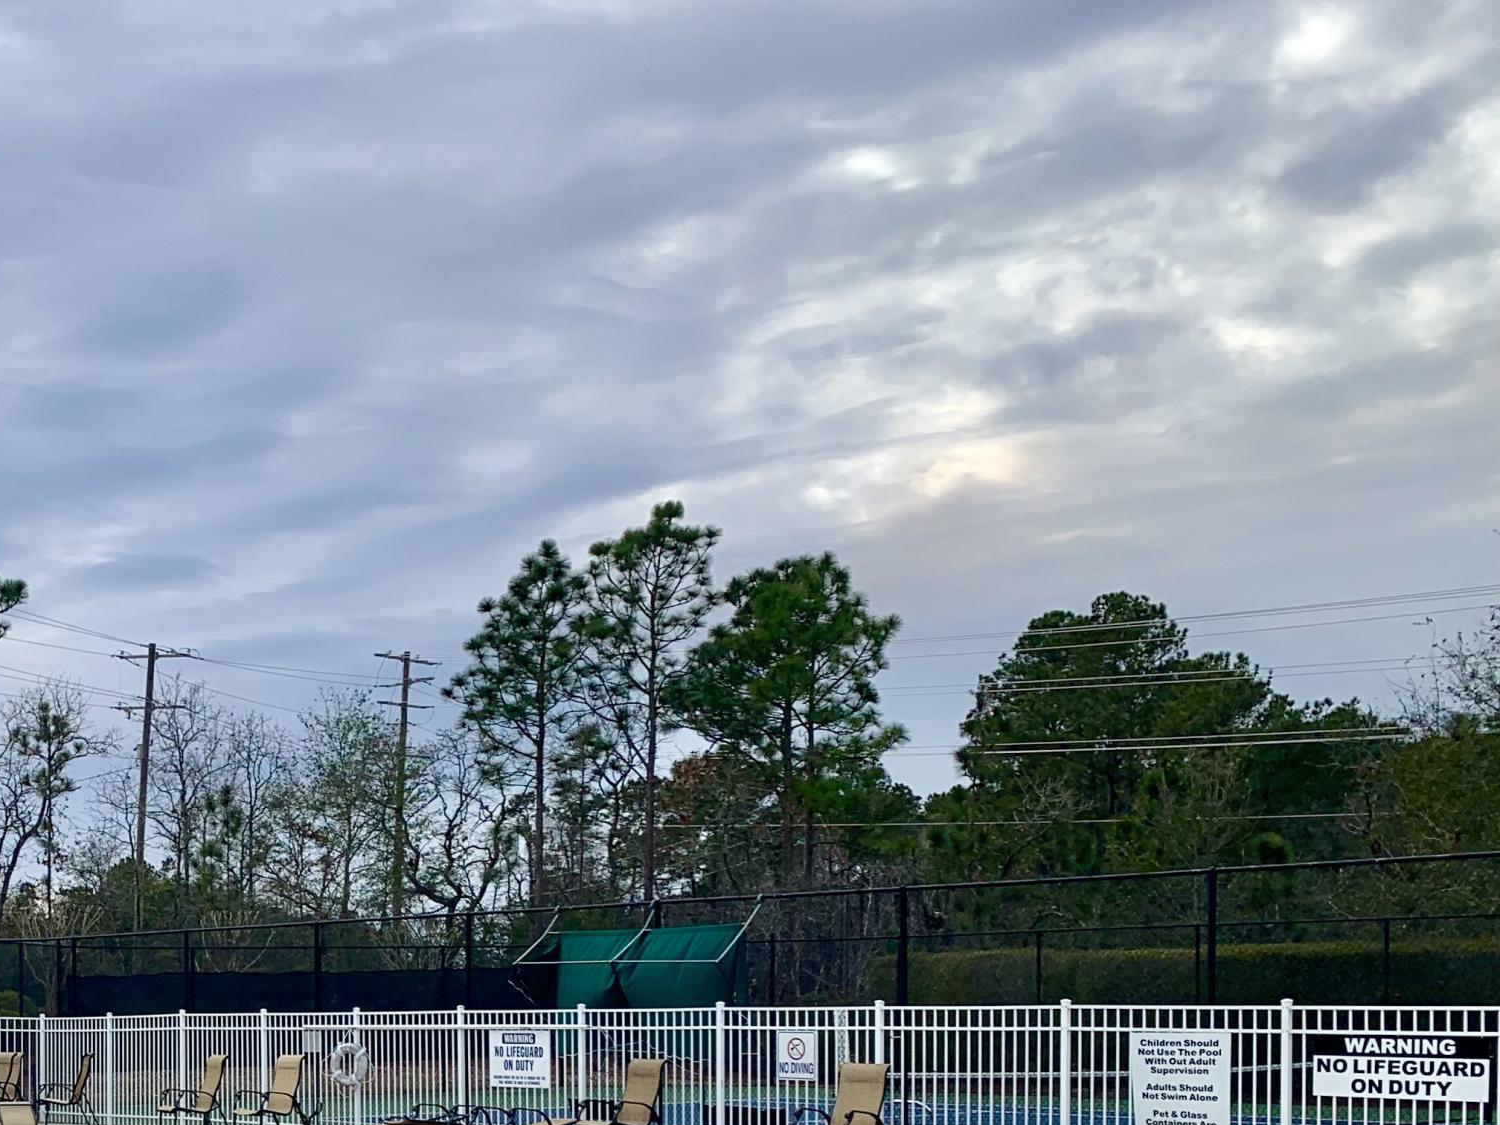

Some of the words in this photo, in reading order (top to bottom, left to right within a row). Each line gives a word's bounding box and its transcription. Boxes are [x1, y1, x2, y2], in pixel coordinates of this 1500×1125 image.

[504, 1035, 533, 1043] WARNING
[1184, 1039, 1219, 1047] Should
[1345, 1038, 1456, 1055] WARNING
[495, 1047, 504, 1057] NO
[507, 1047, 543, 1057] LIFEGUARD
[504, 1060, 513, 1070] ON
[516, 1060, 533, 1071] DUTY
[779, 1063, 789, 1073] NO
[791, 1063, 813, 1074] DIVING
[1317, 1059, 1347, 1072] NO
[1353, 1059, 1485, 1077] LIFEGUARD
[1151, 1067, 1209, 1075] Supervision
[1352, 1079, 1382, 1093] ON
[1389, 1081, 1452, 1096] DUTY
[1181, 1111, 1207, 1119] Glass
